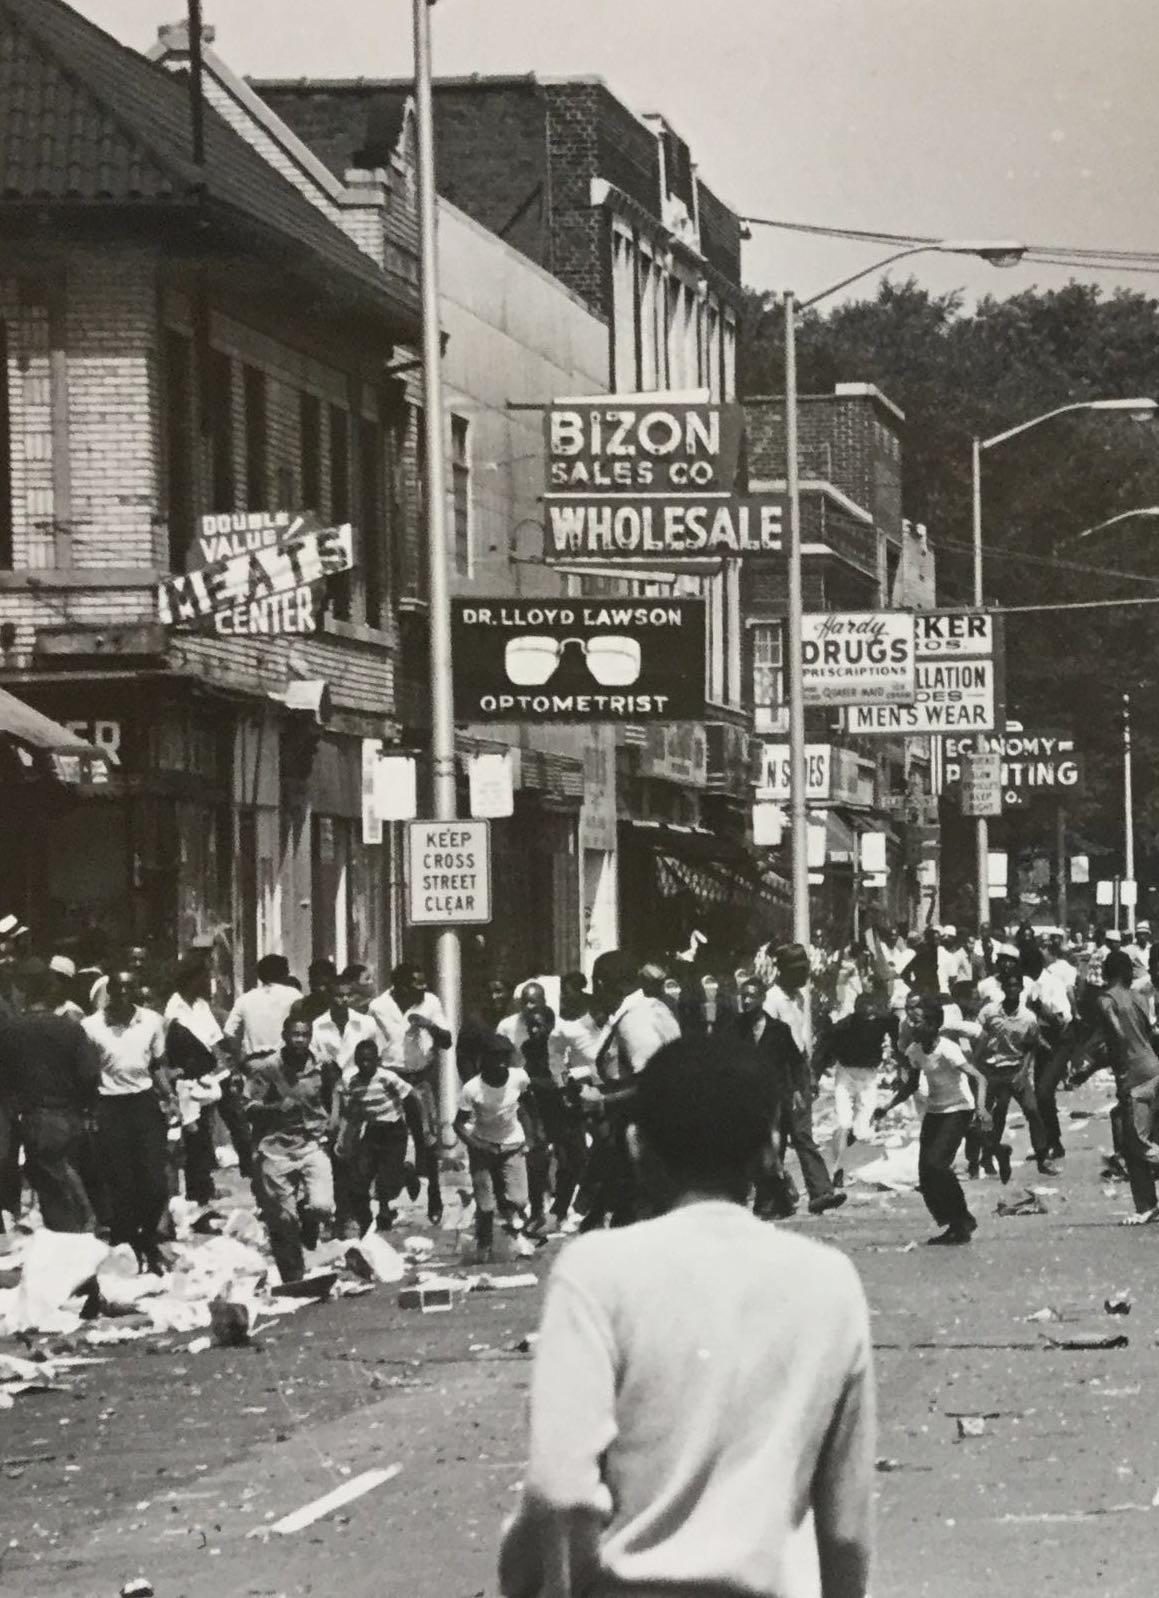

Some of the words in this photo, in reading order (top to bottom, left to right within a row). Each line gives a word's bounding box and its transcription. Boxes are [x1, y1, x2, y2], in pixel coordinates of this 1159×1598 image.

[550, 410, 720, 456] BIZON
[551, 460, 653, 485] SALES
[668, 460, 714, 485] CO
[202, 511, 289, 536] DOUBLE
[550, 505, 783, 551] WHOLESALE
[200, 529, 277, 563] VALUE
[161, 524, 351, 622] MEATS
[214, 585, 316, 634] CENTER
[463, 608, 497, 626] DR.
[501, 608, 575, 626] LLOYD
[583, 608, 682, 626] LAWSON
[814, 616, 889, 641] Hardy
[801, 638, 909, 665] DRUGS
[802, 666, 907, 677] PRESCRIPTIONS
[479, 694, 669, 714] OPTOMETRIST
[926, 704, 988, 726] WEAR
[782, 755, 824, 788] SES
[946, 761, 1079, 786] PTING
[426, 831, 472, 849] KEEP
[423, 853, 475, 869] CROSS
[423, 873, 477, 890] STREET
[424, 895, 475, 912] CLEAR
